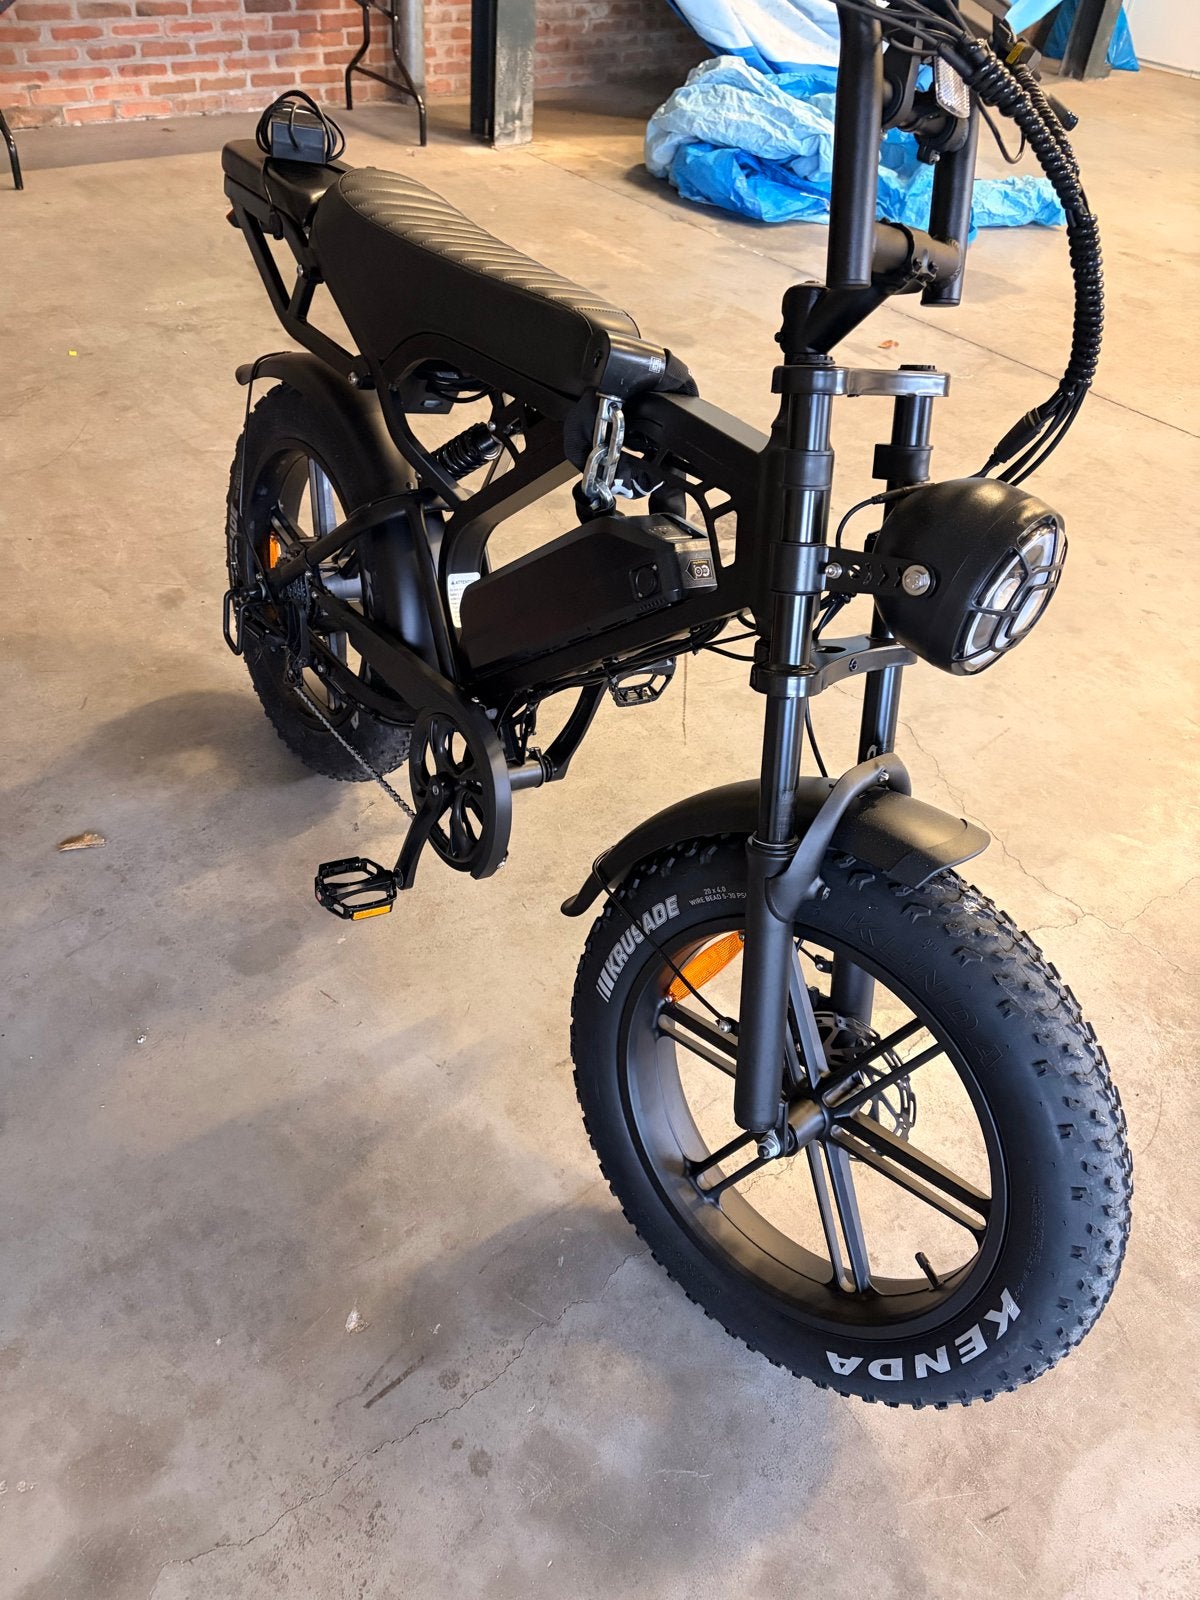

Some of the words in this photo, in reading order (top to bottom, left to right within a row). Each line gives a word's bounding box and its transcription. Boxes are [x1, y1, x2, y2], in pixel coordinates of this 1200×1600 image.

[689, 896, 706, 906] WIRE
[704, 893, 722, 902] BEAD
[703, 887, 712, 895] 20
[602, 894, 681, 984] KRUSADE
[826, 1287, 1022, 1381] KENDA
